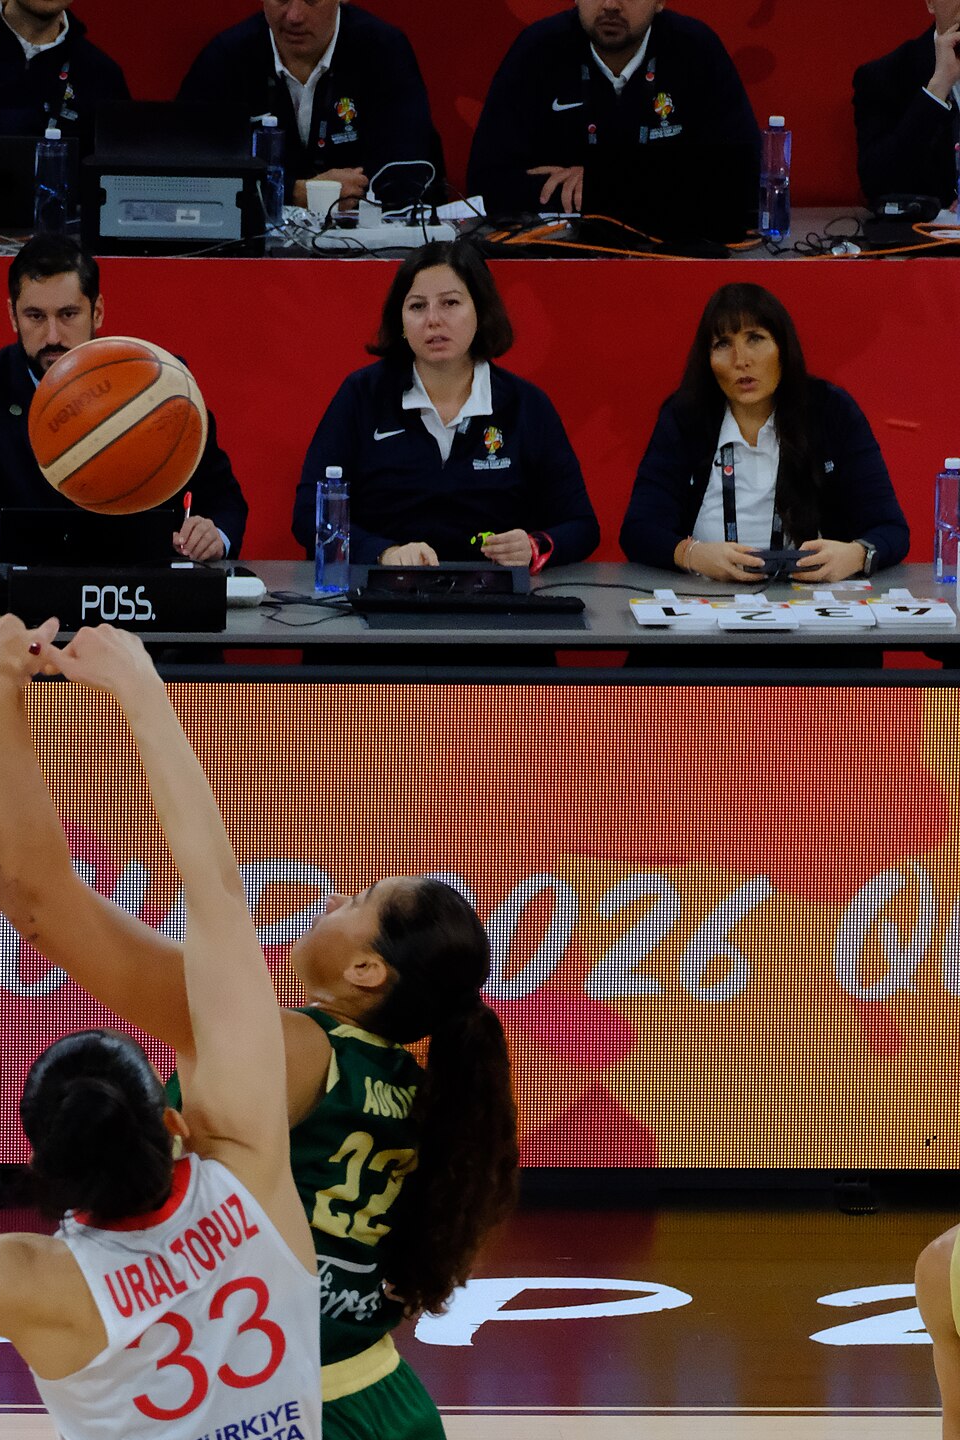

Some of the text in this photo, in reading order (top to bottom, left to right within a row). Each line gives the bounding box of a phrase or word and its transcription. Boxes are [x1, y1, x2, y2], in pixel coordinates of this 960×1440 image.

[47, 378, 112, 434] molten
[81, 584, 156, 621] POSS.
[311, 1131, 418, 1247] 22
[104, 1193, 260, 1319] URAL TOPUZ
[125, 1275, 287, 1421] 33
